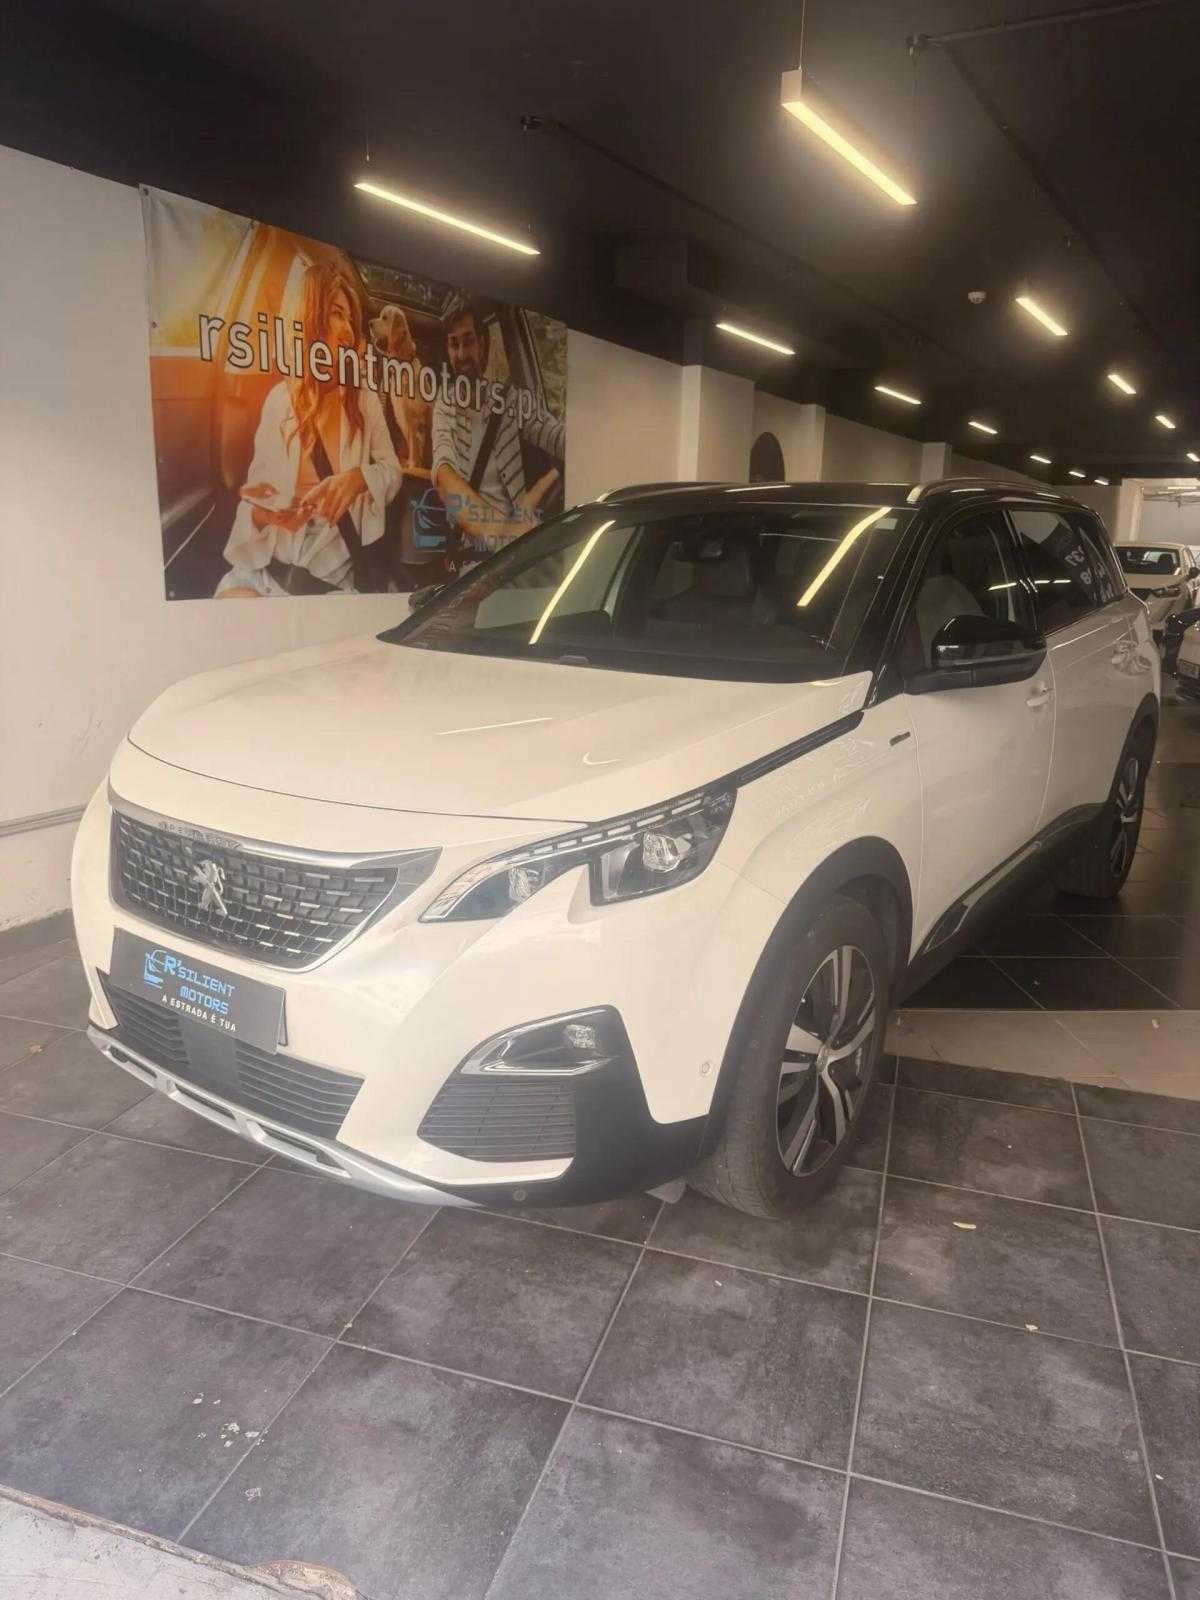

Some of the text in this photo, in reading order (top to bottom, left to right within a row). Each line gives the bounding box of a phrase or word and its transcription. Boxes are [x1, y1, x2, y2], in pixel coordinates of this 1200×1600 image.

[161, 994, 168, 1003] A
[170, 998, 208, 1020] ESTRADA
[220, 1018, 236, 1032] TUA
[180, 985, 229, 1015] MOTORS
